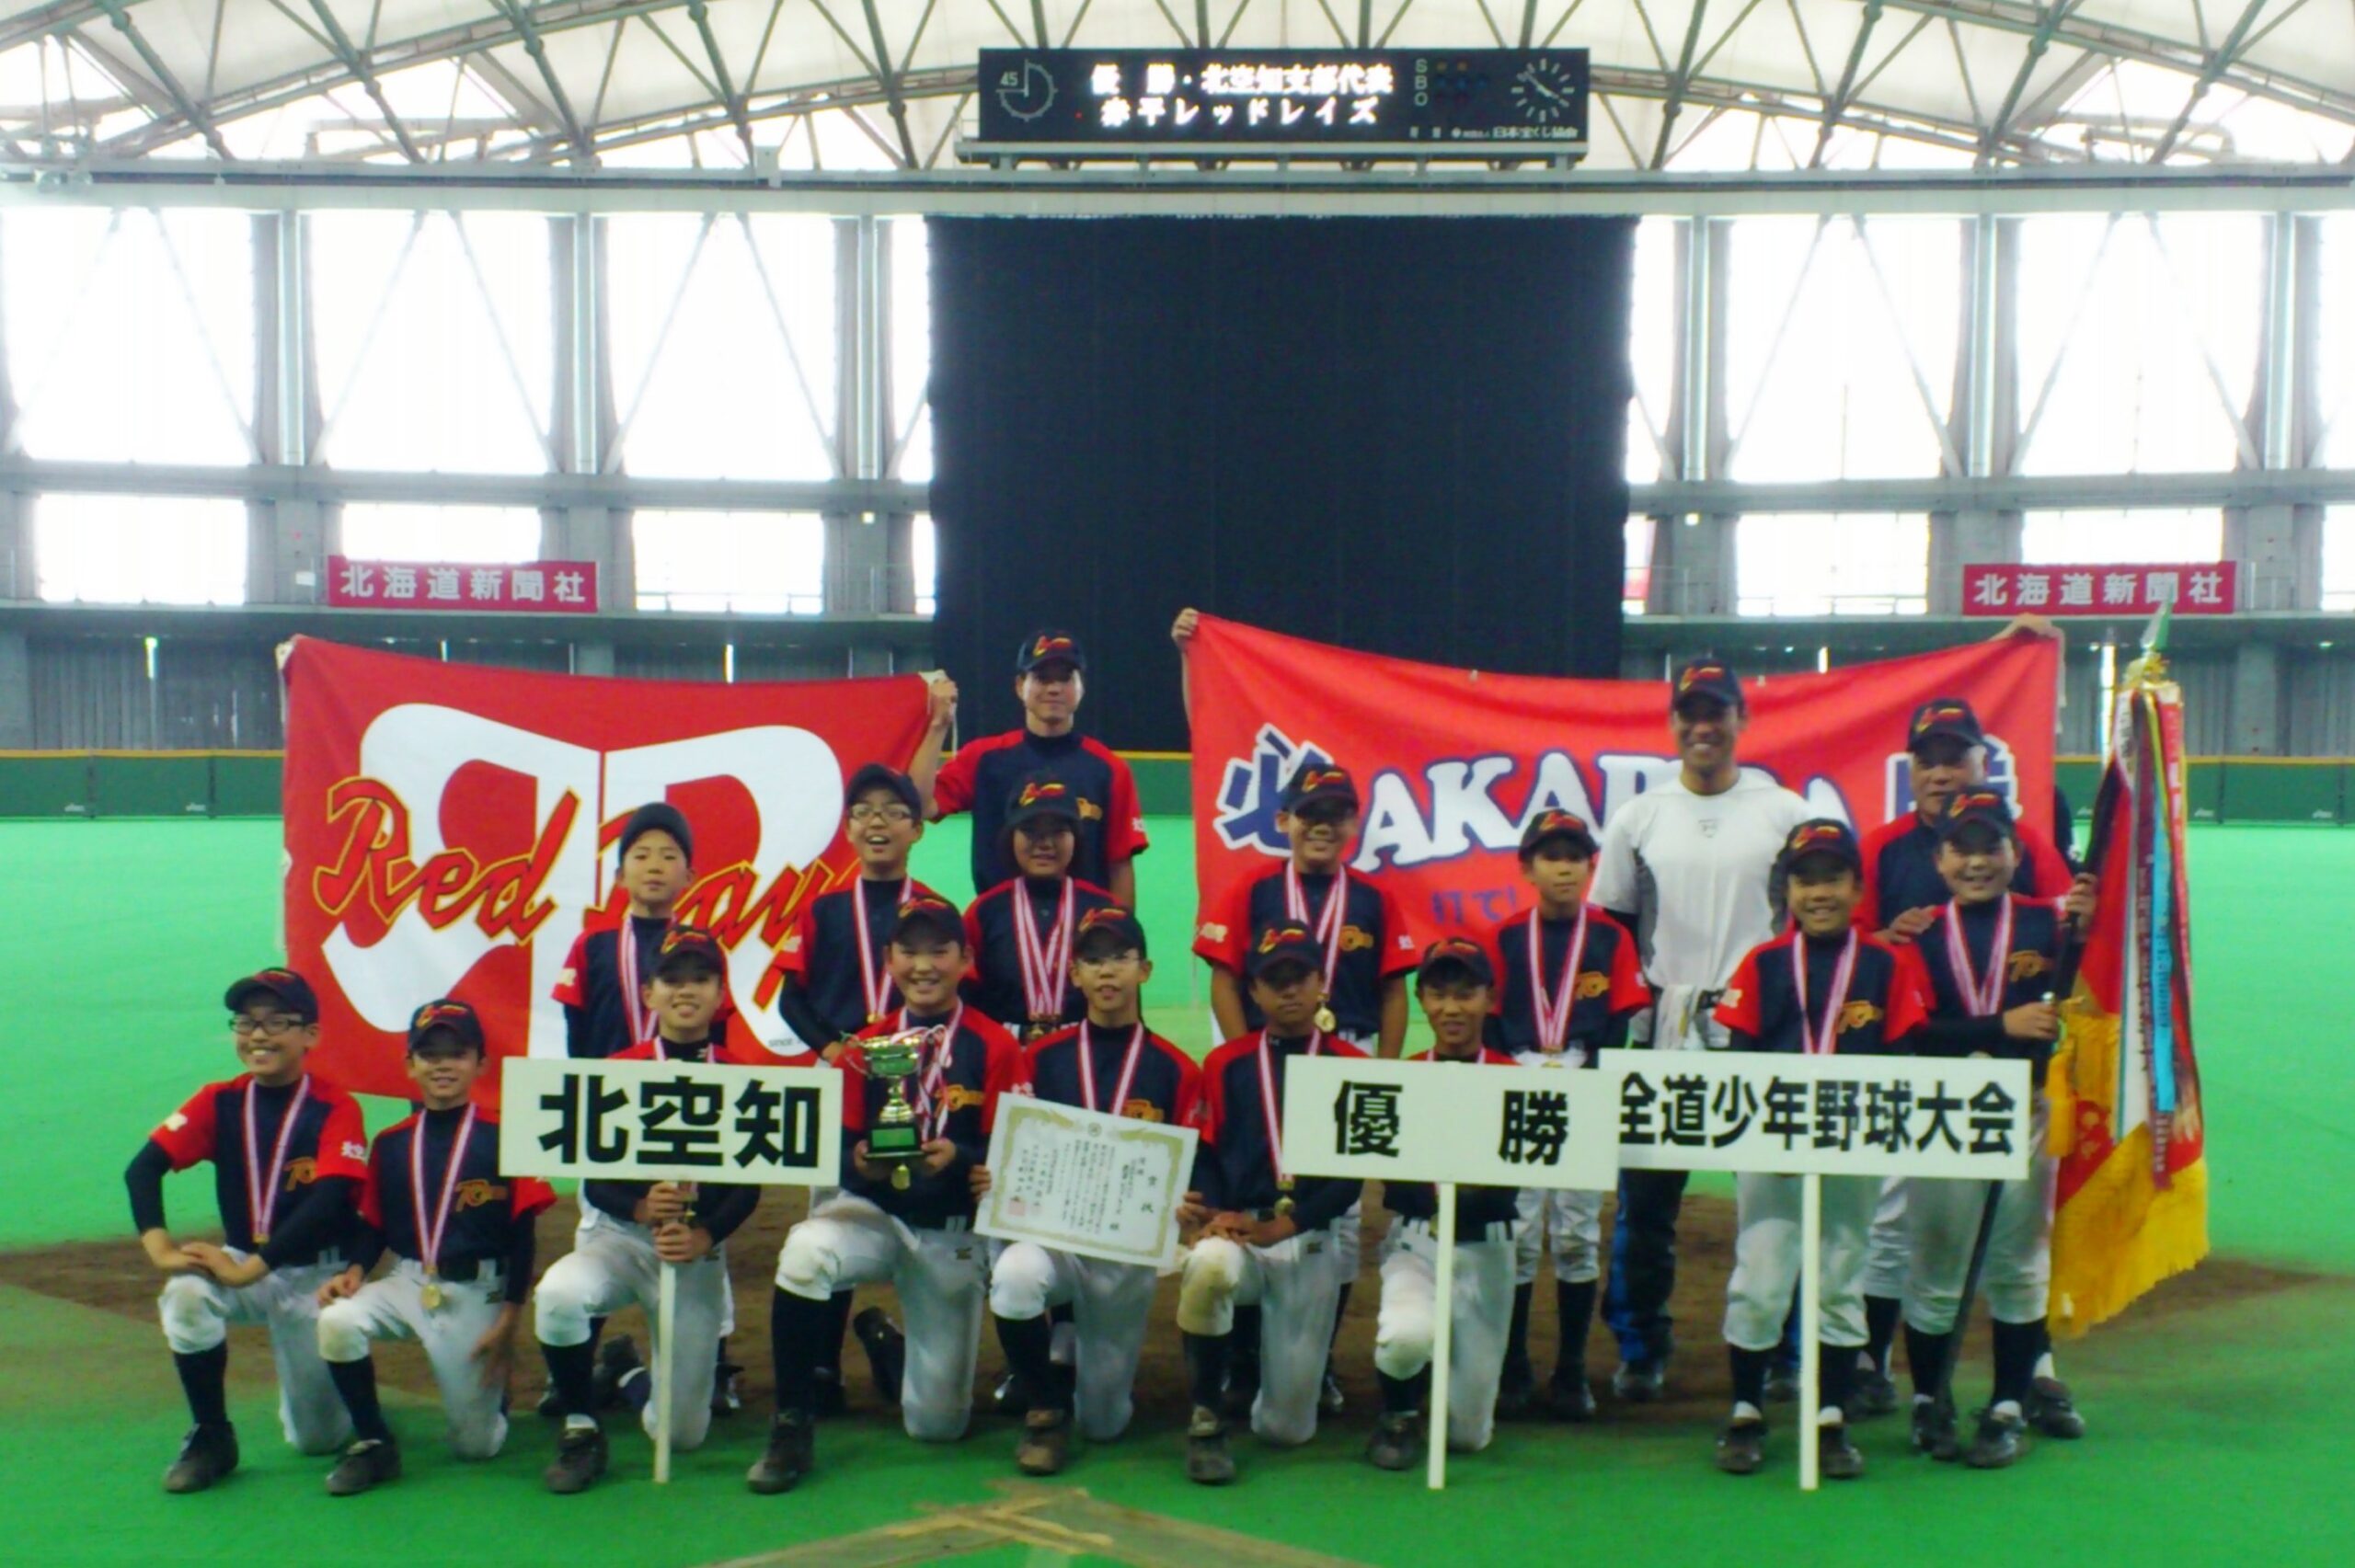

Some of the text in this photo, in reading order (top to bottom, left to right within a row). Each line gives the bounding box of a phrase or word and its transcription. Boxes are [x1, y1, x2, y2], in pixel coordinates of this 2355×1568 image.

[1000, 71, 1018, 86] 45
[339, 564, 586, 602] 北海道新聞社
[1972, 570, 2223, 606] 北海道新聞社
[313, 774, 863, 1013] Red ay
[537, 1073, 821, 1168] 北空知
[1619, 1071, 2016, 1156] 全道少年野球大会
